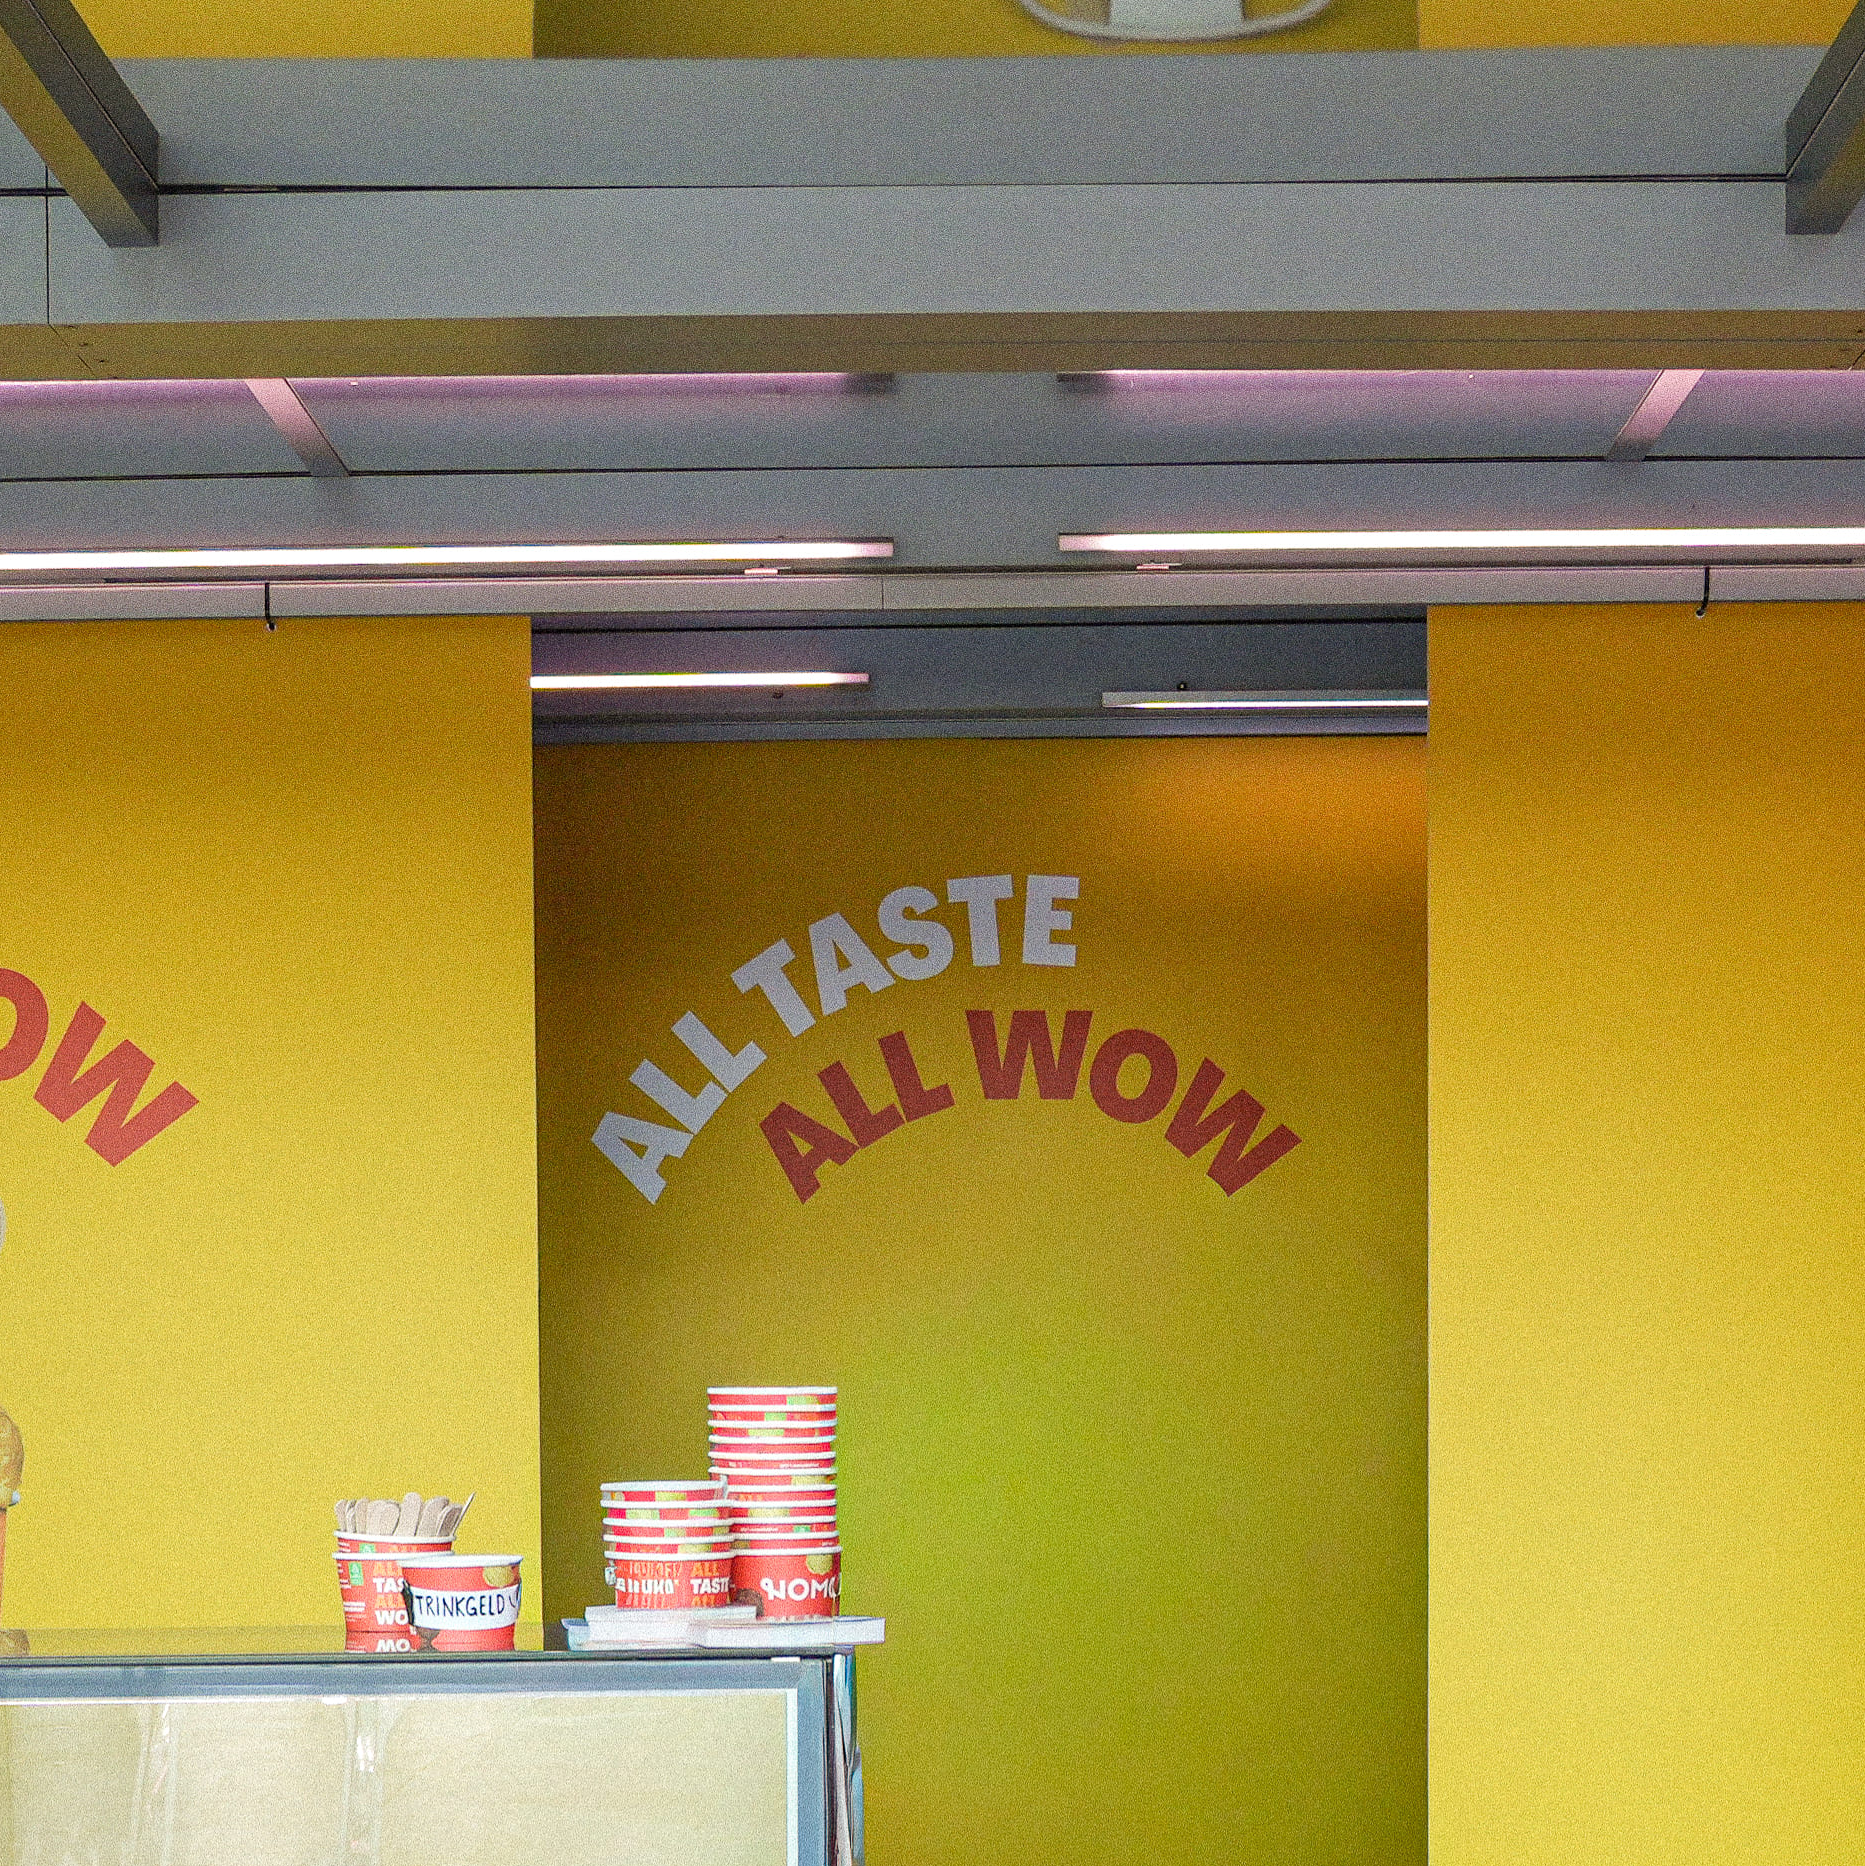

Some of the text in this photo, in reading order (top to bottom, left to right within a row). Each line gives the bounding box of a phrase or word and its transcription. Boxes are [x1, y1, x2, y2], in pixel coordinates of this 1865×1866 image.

[590, 874, 1080, 1204] ALL TASTE
[758, 1010, 1303, 1204] ALL WOW
[415, 1593, 506, 1617] TRINKGELD
[691, 1562, 719, 1576] ALL
